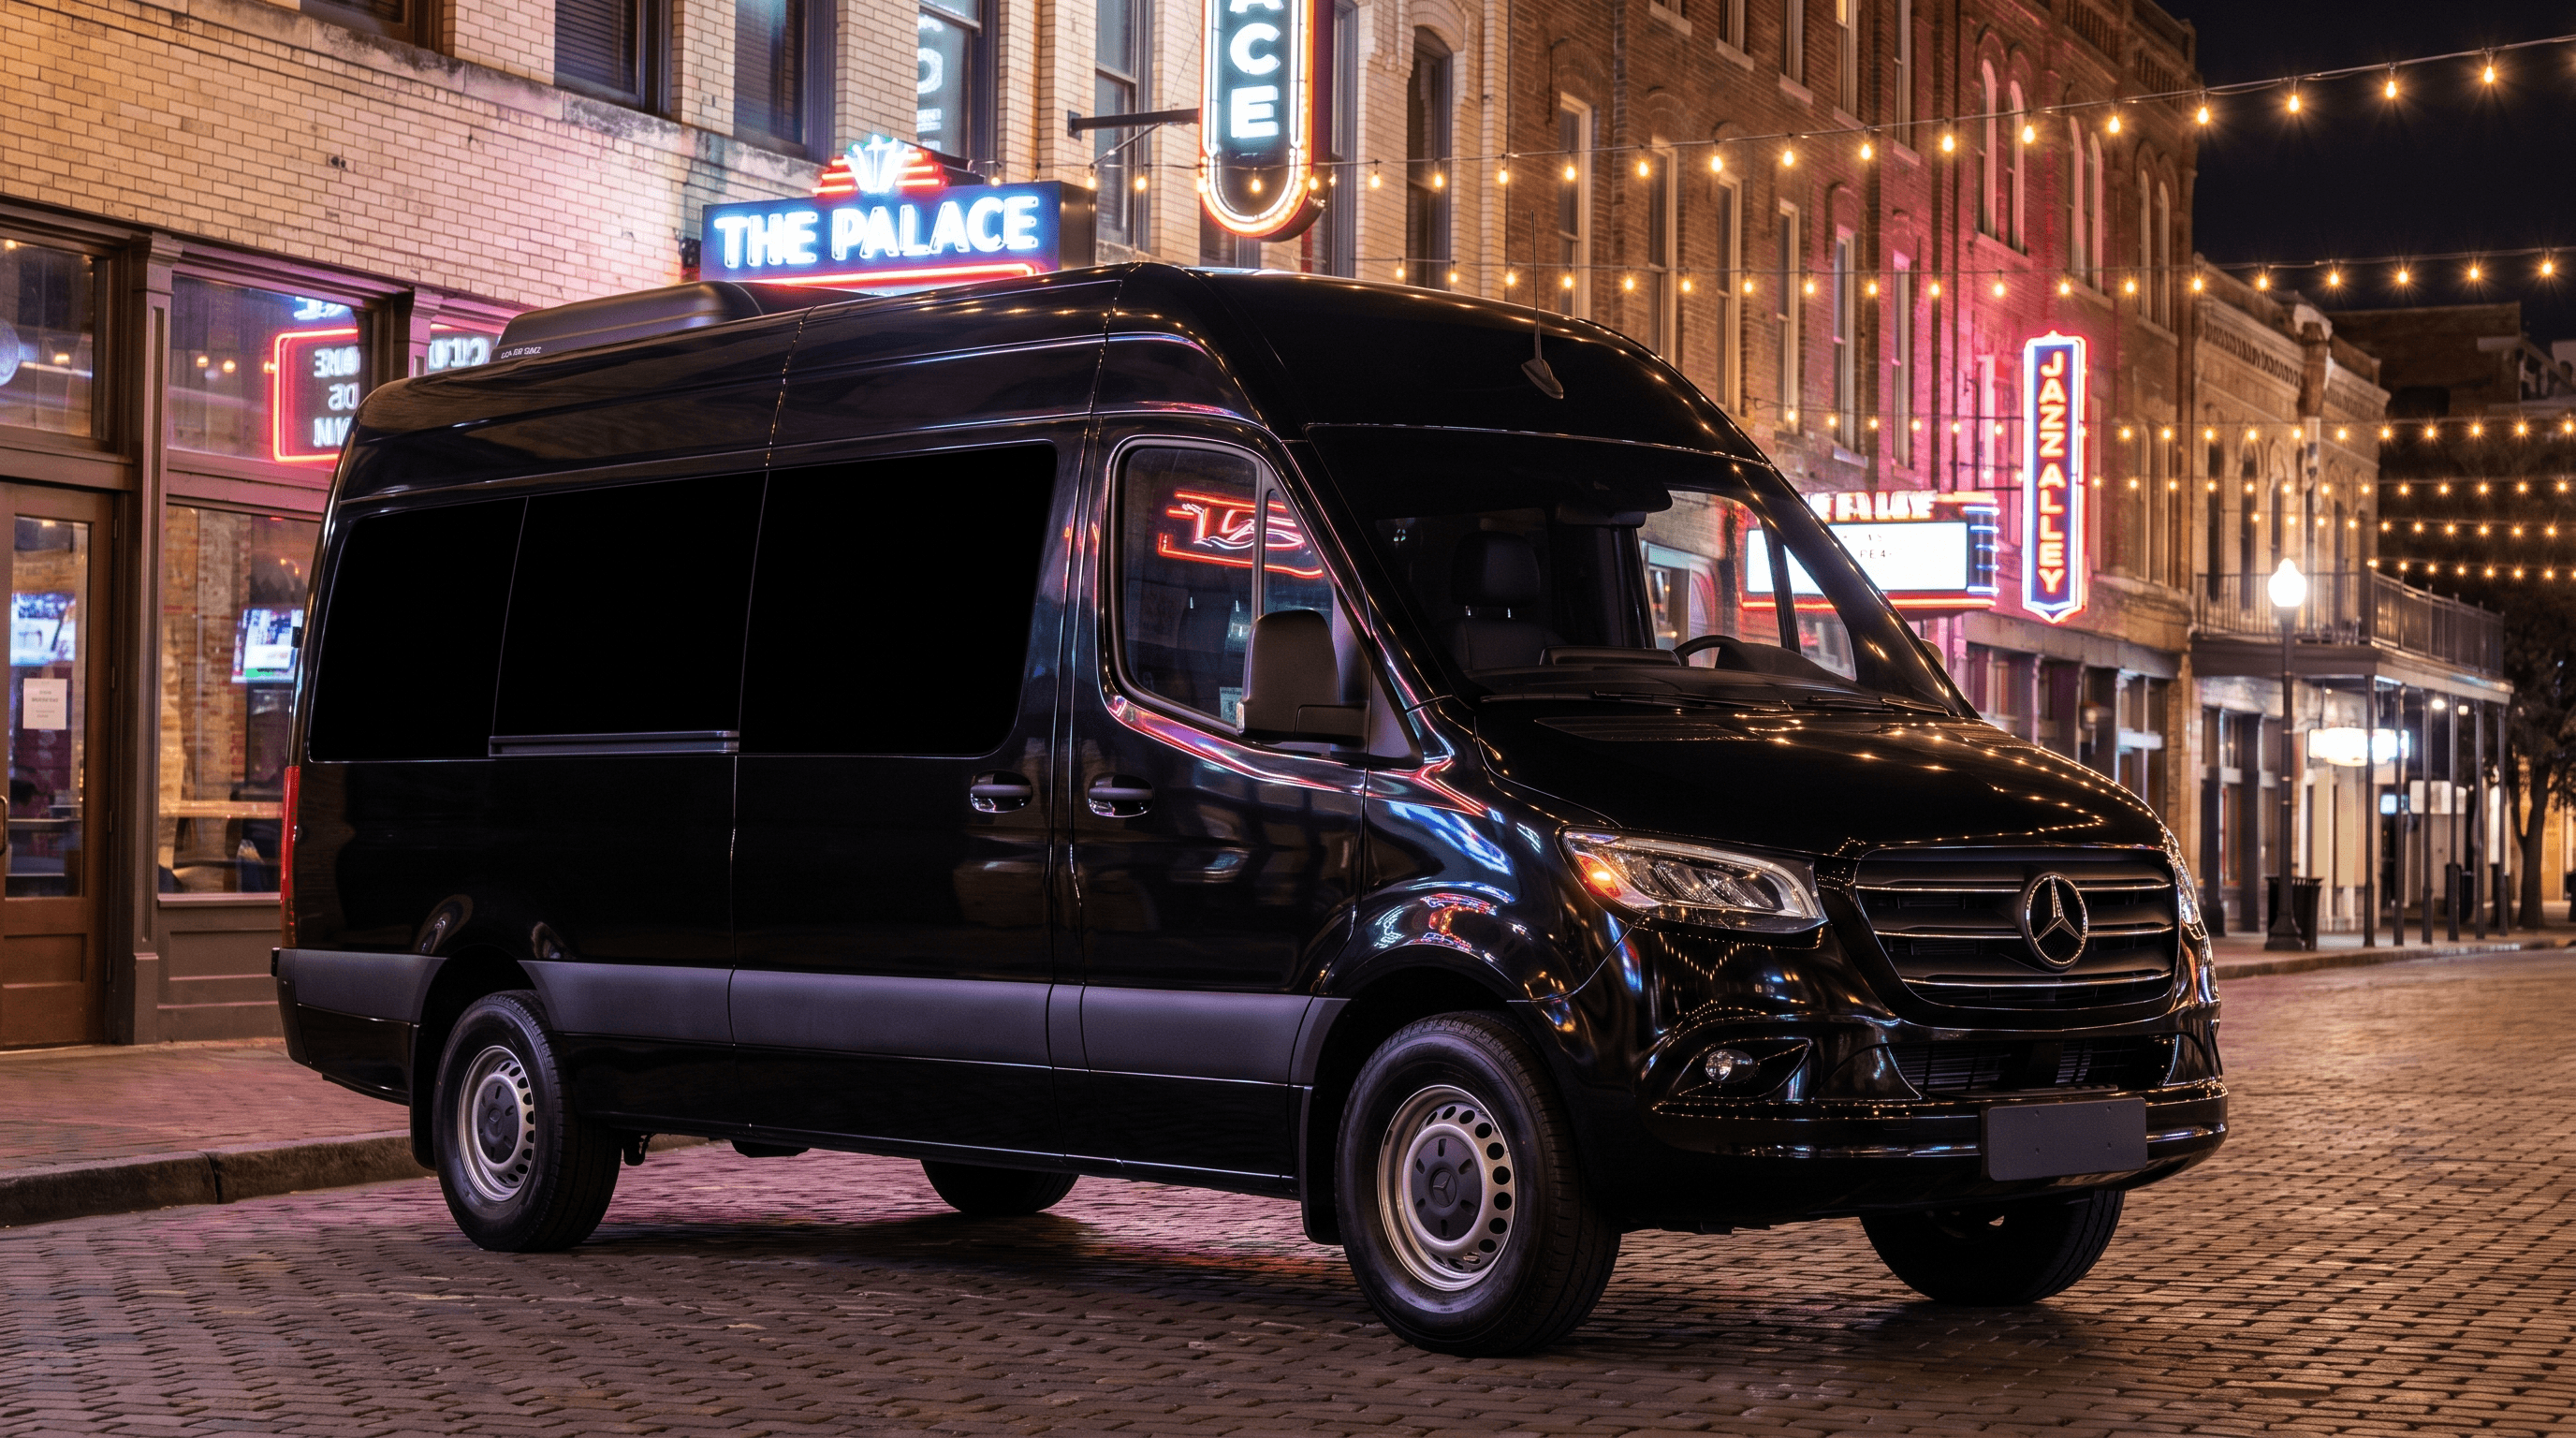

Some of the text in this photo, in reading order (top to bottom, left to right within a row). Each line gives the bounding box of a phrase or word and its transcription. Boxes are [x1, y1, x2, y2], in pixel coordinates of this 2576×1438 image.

[1228, 0, 1284, 139] CE
[714, 196, 1040, 269] THE PALACE
[2037, 350, 2067, 594] JAZZ ALLEY
